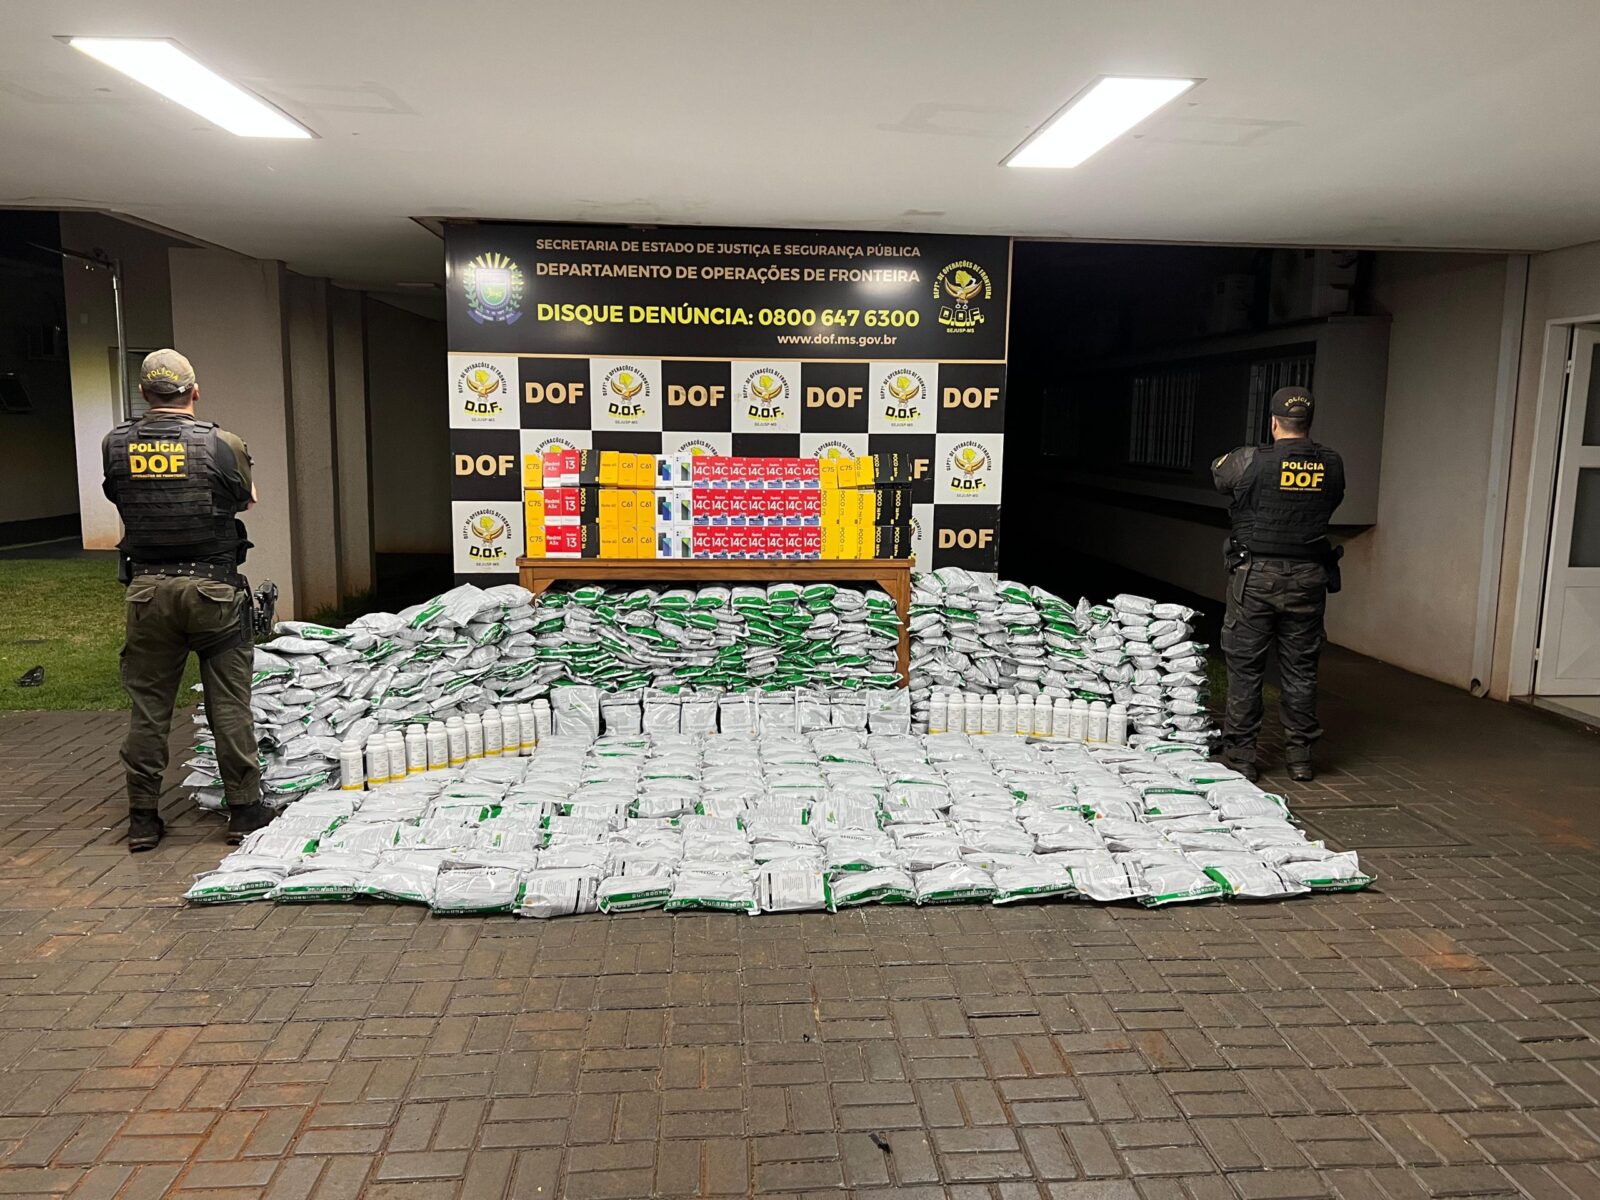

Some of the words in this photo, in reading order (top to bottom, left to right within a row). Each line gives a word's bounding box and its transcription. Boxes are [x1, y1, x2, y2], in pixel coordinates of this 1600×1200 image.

[536, 239, 619, 252] SECRETARIA
[621, 241, 640, 252] DE
[642, 242, 695, 253] ESTADO
[697, 243, 715, 254] DE
[717, 244, 769, 257] JUSTIÇA
[774, 245, 781, 255] E
[784, 245, 864, 259] SEGURANÇA
[866, 244, 921, 257] PÚBLICA
[536, 263, 672, 278] DEPARTAMENTO
[675, 266, 698, 280] DE
[701, 265, 800, 284] OPERAÇÕES
[804, 269, 826, 281] DE
[829, 269, 920, 283] FRONTEIRA
[537, 304, 624, 326] DISQUE
[629, 302, 754, 326] DENÚNCIA:
[758, 308, 816, 326] 0800
[821, 309, 860, 327] 647
[864, 310, 920, 328] 6300
[777, 334, 898, 346] www.dof.ms.gov.br
[147, 367, 178, 381] POLÍCIA
[525, 382, 585, 404] DOF
[668, 385, 725, 407] DOF
[806, 387, 863, 408] DOF
[943, 387, 1000, 409] DOF
[1284, 396, 1310, 407] POLÍCIA
[129, 441, 184, 452] POLÍCIA
[130, 455, 185, 473] DOF
[455, 454, 515, 476] DOF
[565, 461, 575, 469] 13
[1282, 461, 1324, 470] POLÍCIA
[693, 466, 710, 475] 14C
[712, 466, 729, 475] 14C
[730, 467, 747, 476] 14C
[748, 467, 765, 476] 14C
[766, 467, 783, 476] 14C
[784, 467, 801, 476] 14C
[802, 468, 819, 476] 14C
[1281, 472, 1324, 487] DOF
[566, 501, 576, 511] 13
[694, 500, 711, 510] 14C
[712, 500, 729, 510] 14C
[730, 500, 748, 510] 14C
[749, 500, 766, 510] 14C
[768, 500, 784, 510] 14C
[786, 501, 802, 510] 14C
[804, 501, 820, 510] 14C
[566, 538, 577, 547] 13
[694, 537, 711, 547] 14C
[712, 537, 729, 547] 14C
[730, 537, 747, 547] 14C
[749, 537, 766, 547] 14C
[768, 538, 784, 547] 14C
[786, 538, 802, 547] 14C
[804, 538, 820, 548] 14C
[939, 528, 994, 549] DOF
